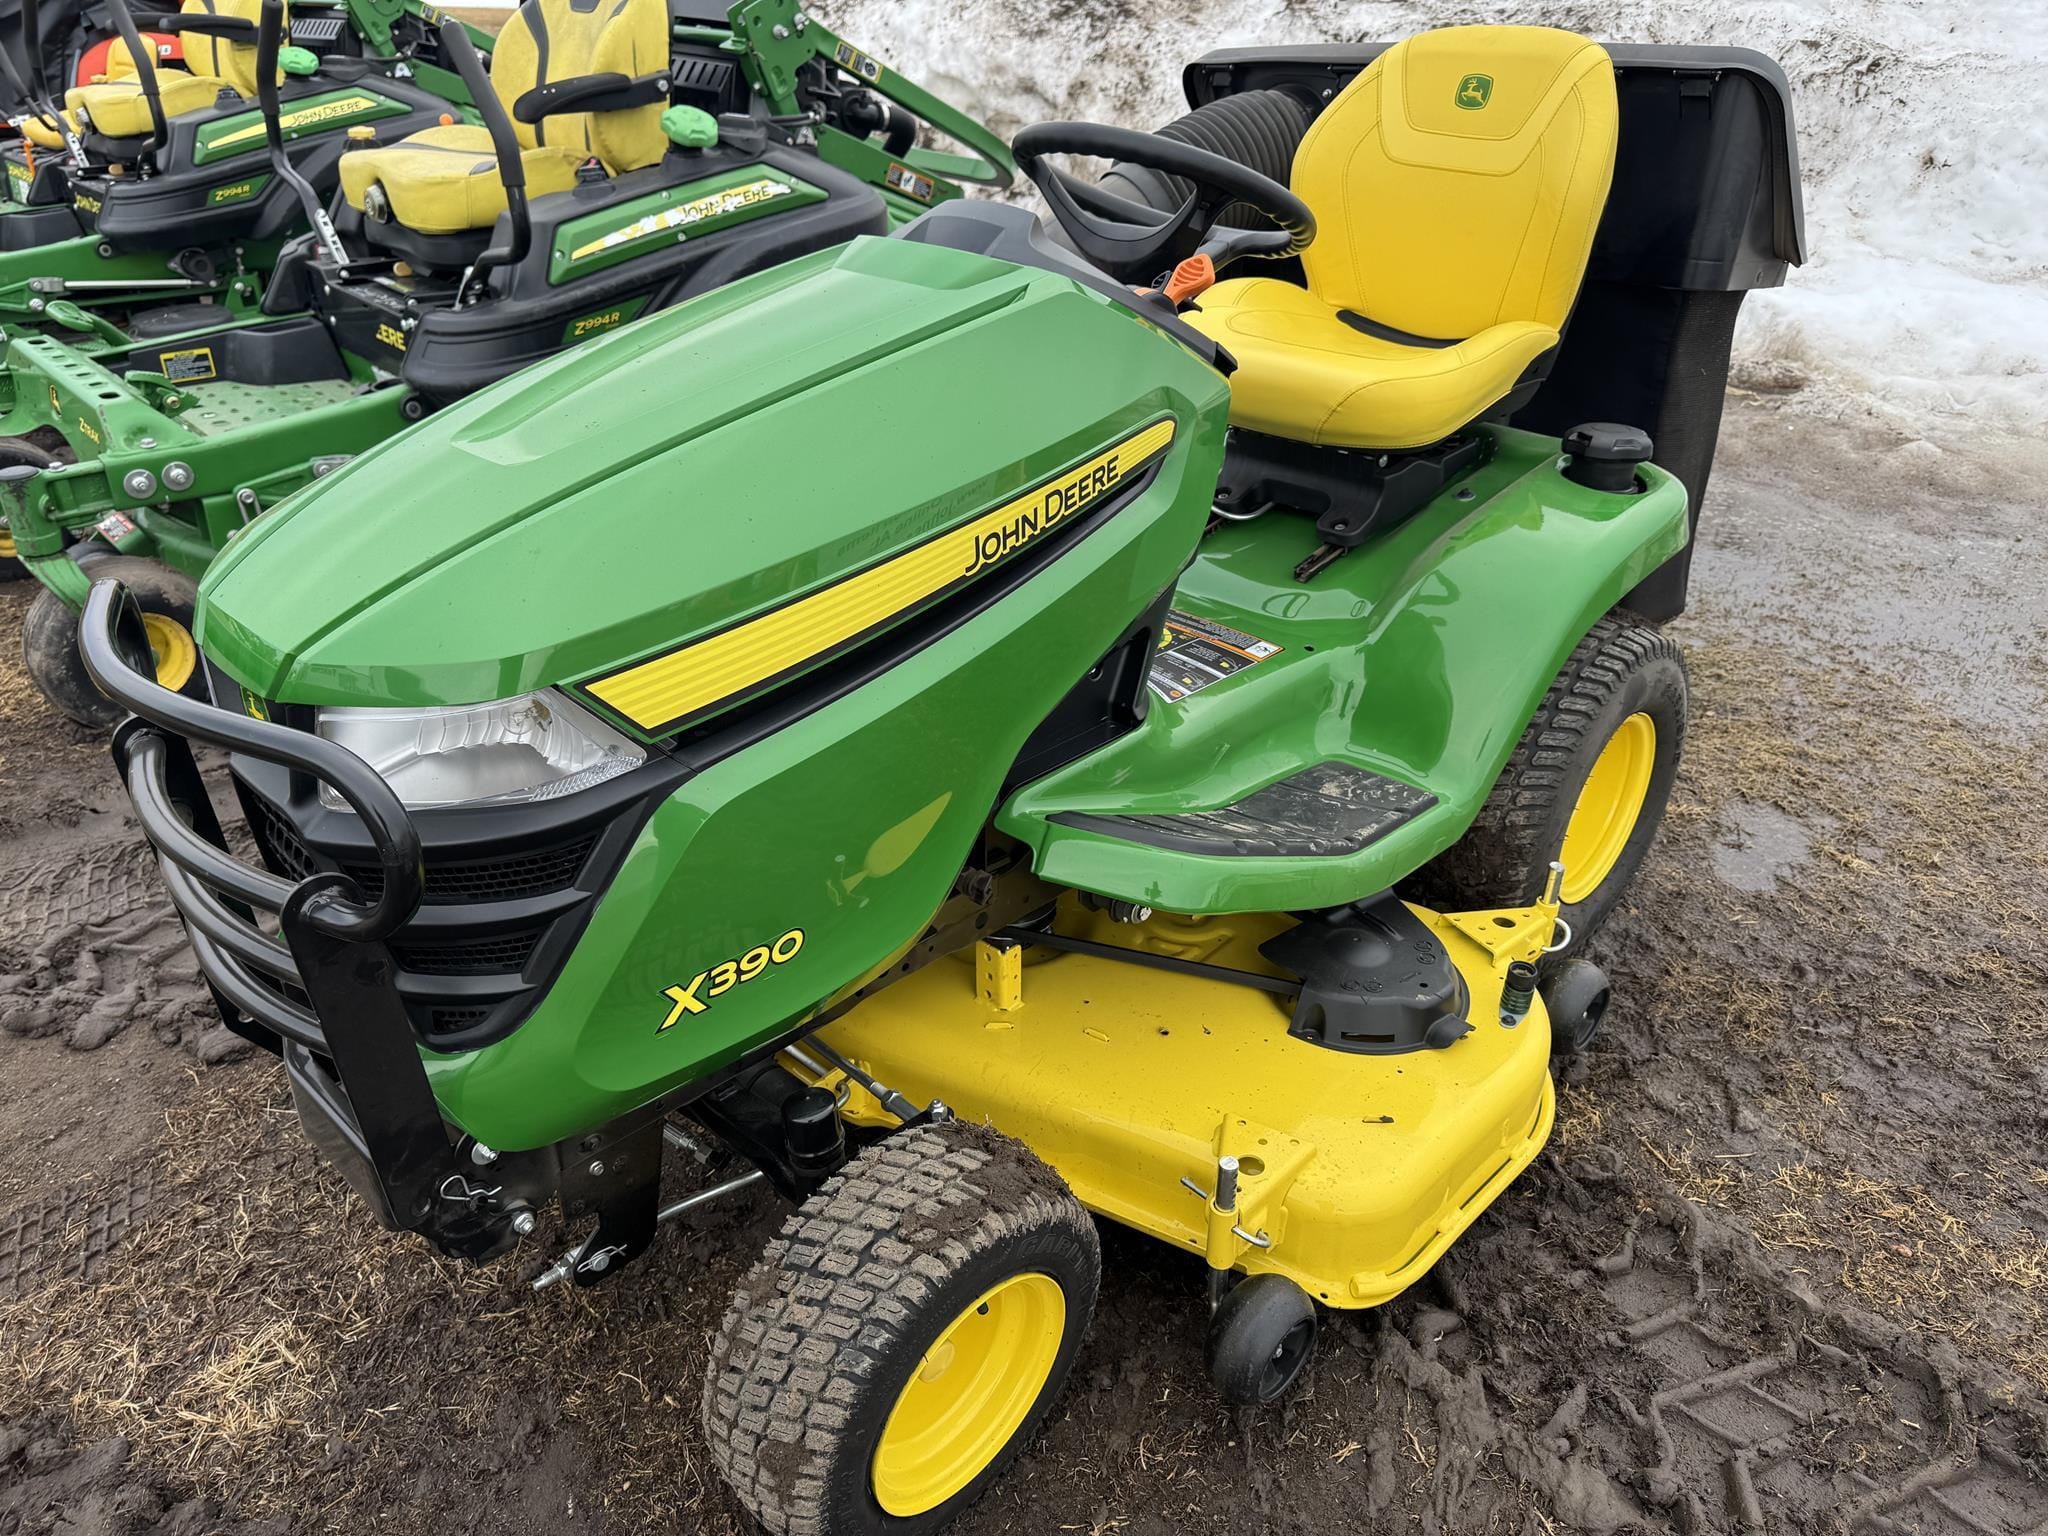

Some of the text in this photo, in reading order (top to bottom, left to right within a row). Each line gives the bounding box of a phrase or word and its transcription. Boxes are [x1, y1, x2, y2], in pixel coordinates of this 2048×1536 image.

[290, 101, 362, 128] JOHN DEERE
[215, 184, 251, 201] Z994R
[574, 311, 620, 335] Z994R
[965, 454, 1120, 575] JOHN DEERE
[655, 927, 806, 1035] X390
